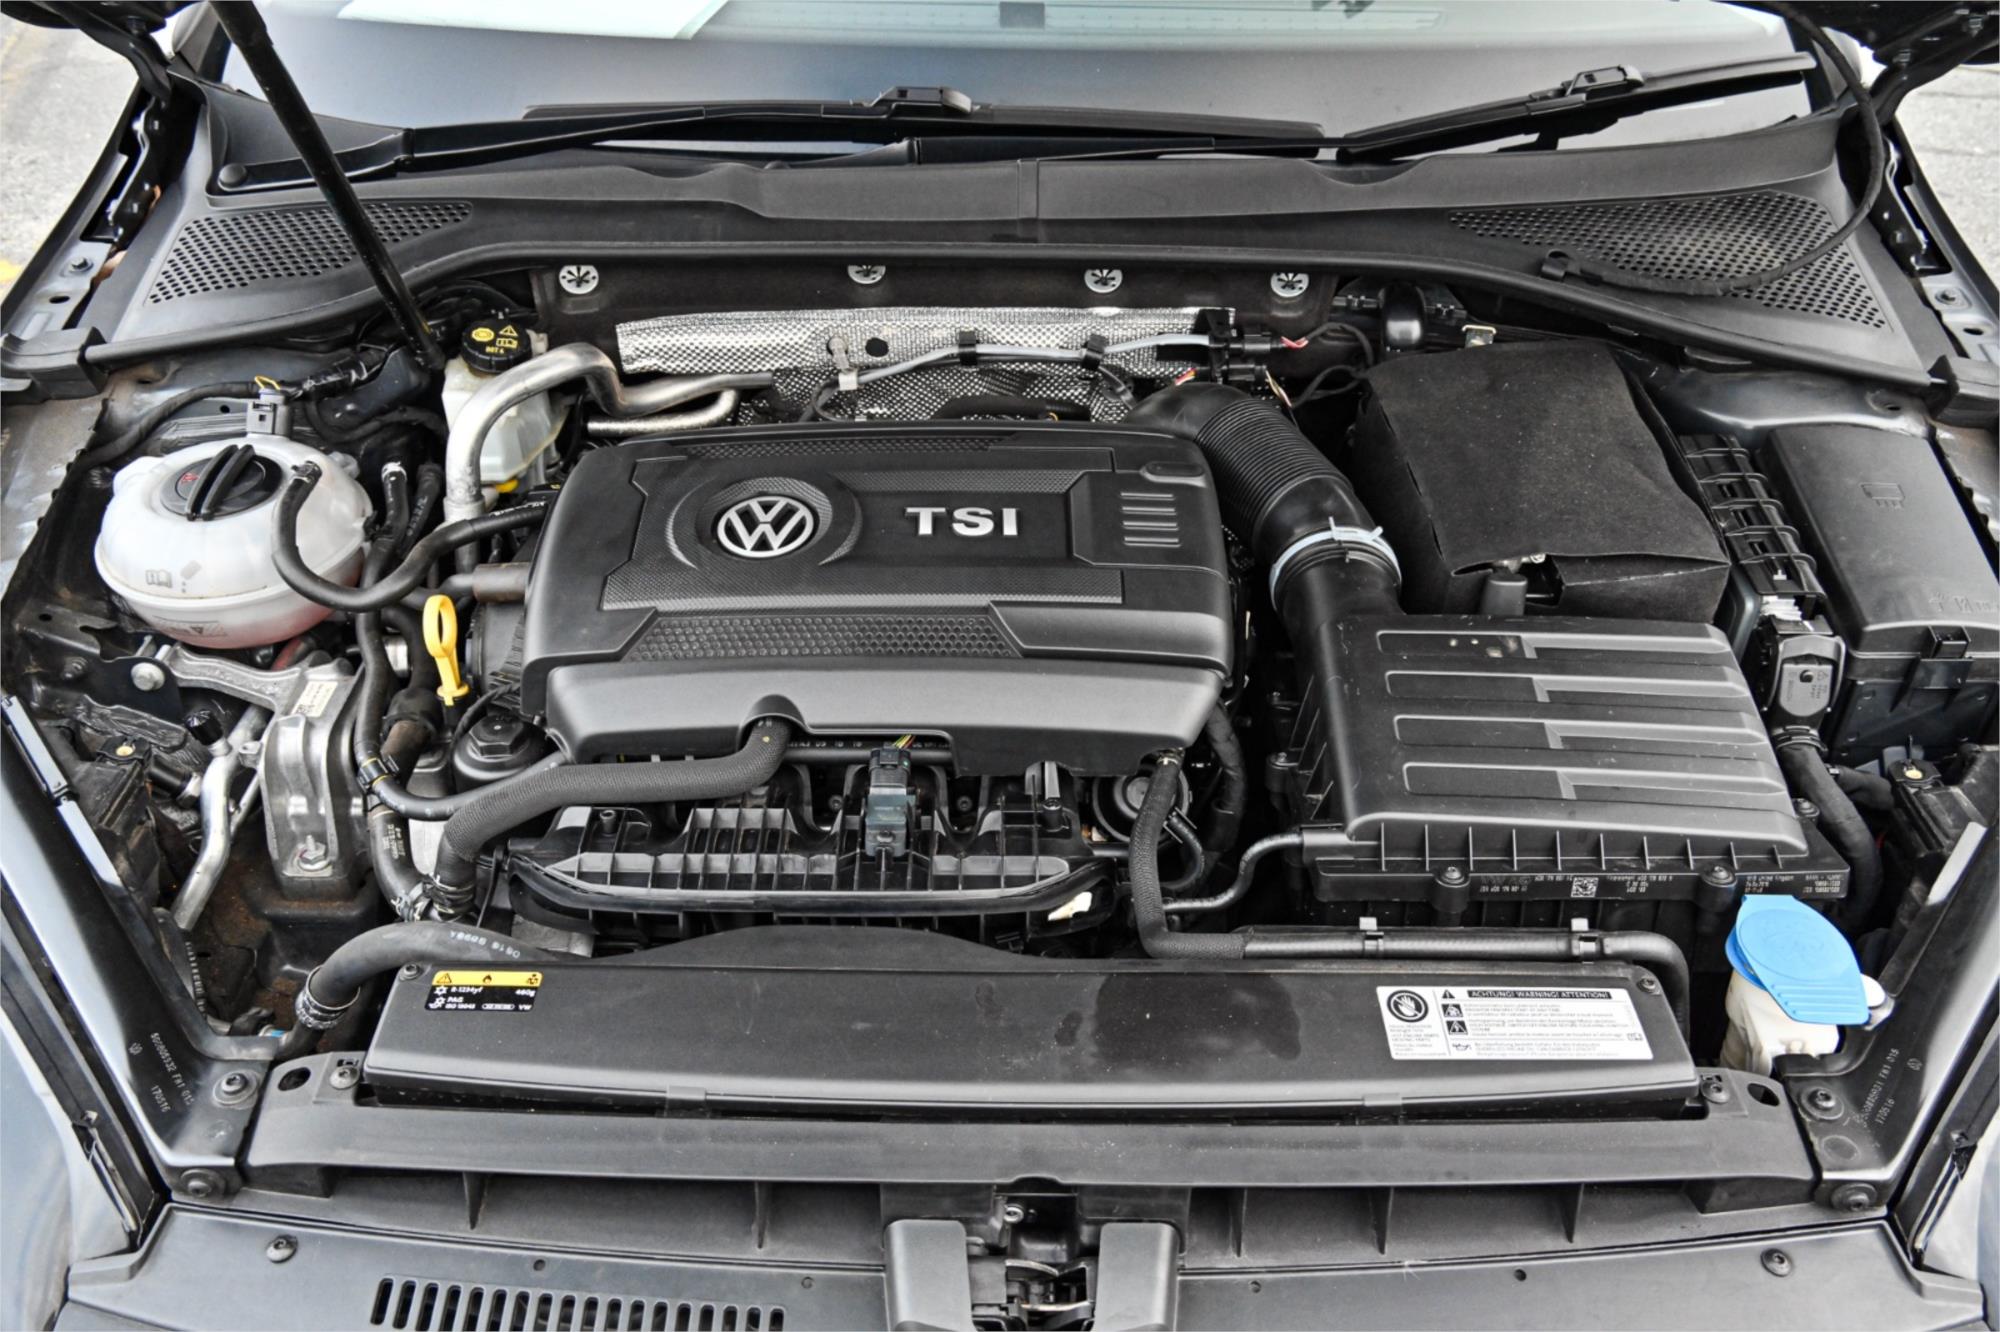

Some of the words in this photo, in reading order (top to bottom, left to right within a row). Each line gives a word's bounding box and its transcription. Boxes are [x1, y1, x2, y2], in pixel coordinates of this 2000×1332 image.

[717, 495, 815, 559] VW
[905, 506, 1019, 537] TSI
[1471, 989, 1513, 998] ACHTUNG!
[1515, 990, 1559, 999] WARNING!
[1560, 991, 1609, 999] ATTENTION!
